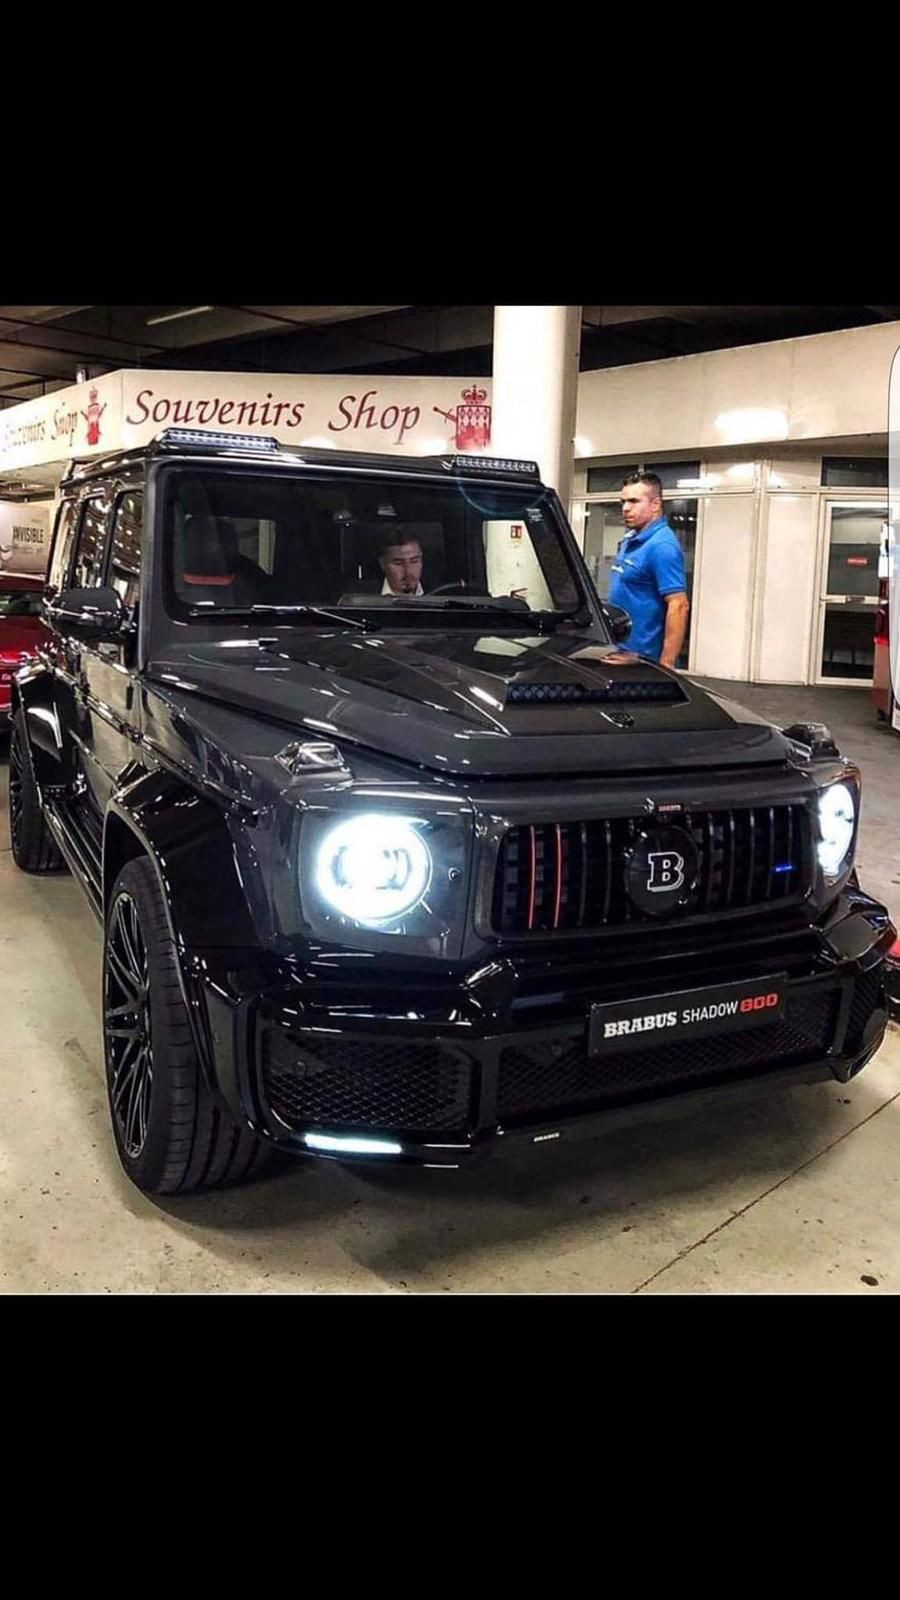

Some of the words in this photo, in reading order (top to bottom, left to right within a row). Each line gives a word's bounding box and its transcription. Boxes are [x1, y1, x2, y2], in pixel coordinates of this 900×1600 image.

[2, 416, 46, 453] venirs
[126, 389, 305, 427] Souvenirs
[328, 390, 420, 446] Shop
[646, 851, 685, 893] B
[603, 1012, 678, 1038] BRABUS
[682, 1001, 739, 1024] SHADOW
